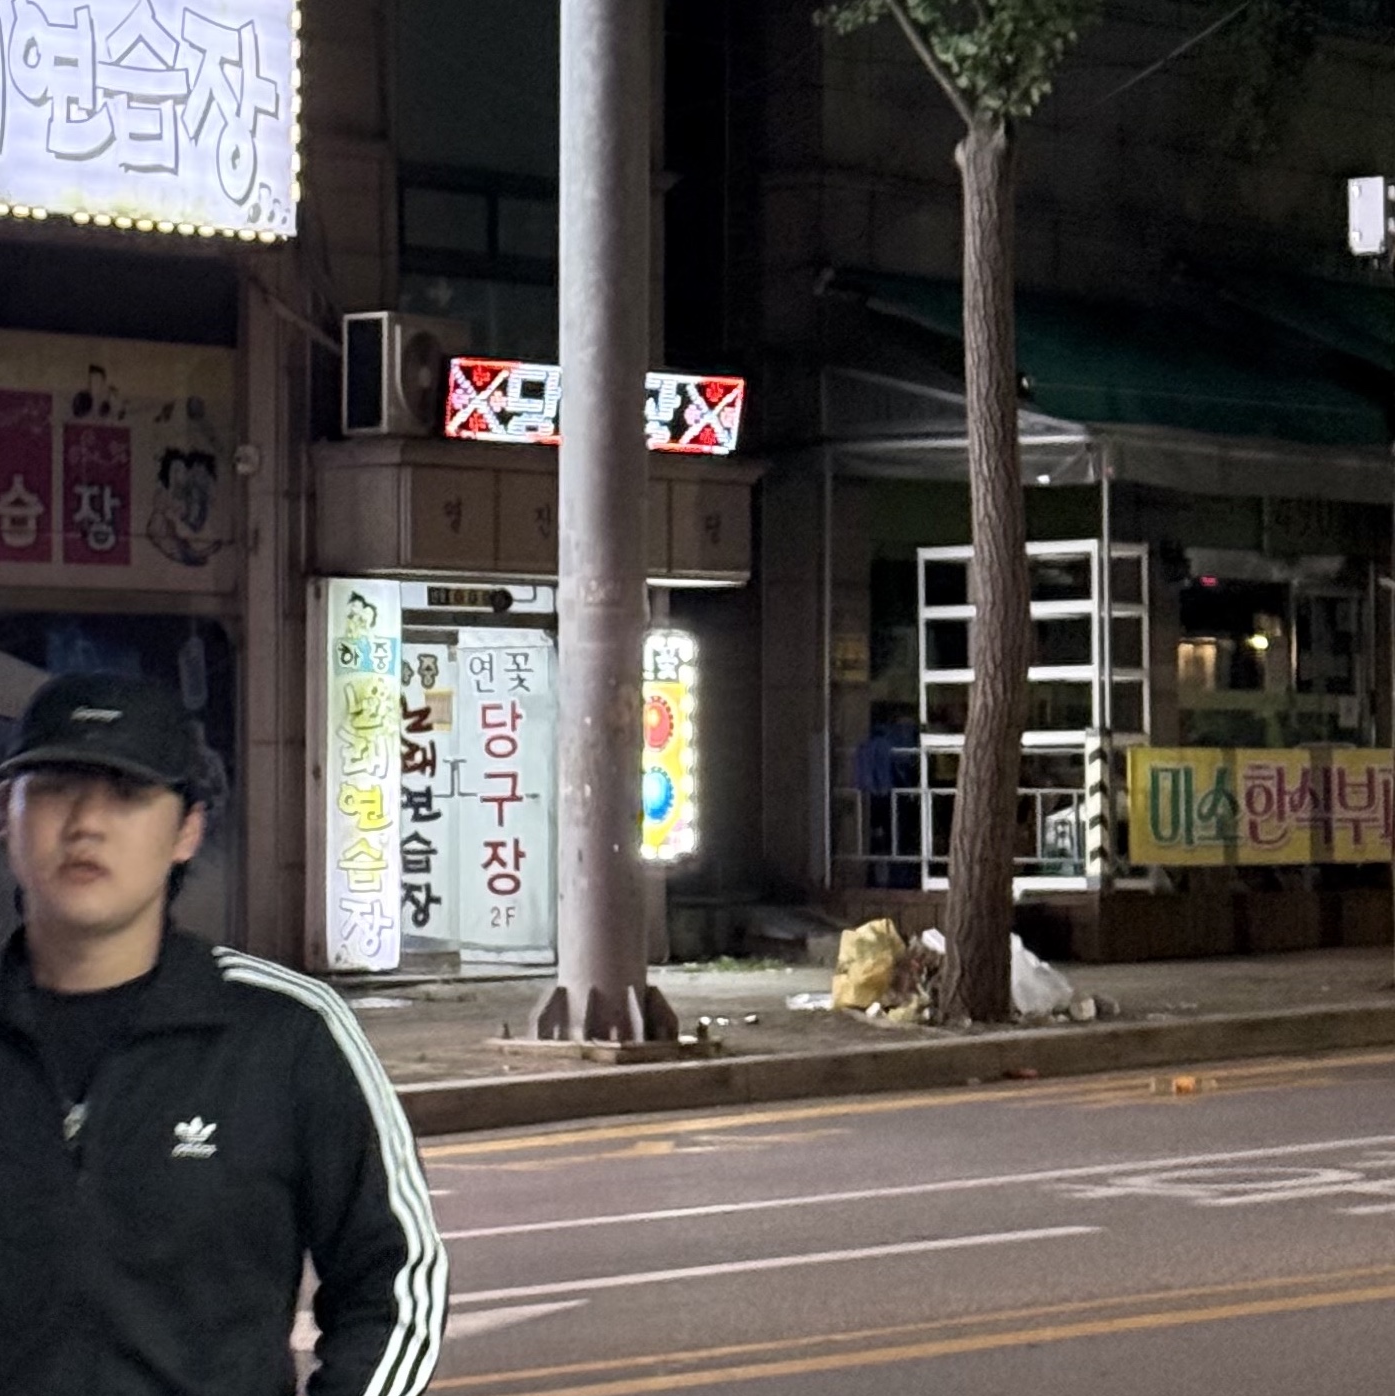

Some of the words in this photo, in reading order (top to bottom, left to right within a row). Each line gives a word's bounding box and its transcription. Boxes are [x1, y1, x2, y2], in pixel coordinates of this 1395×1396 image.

[337, 638, 391, 674] 하중
[469, 652, 534, 693] 연꽃
[479, 701, 526, 896] 당구장
[490, 906, 516, 928] 2F
